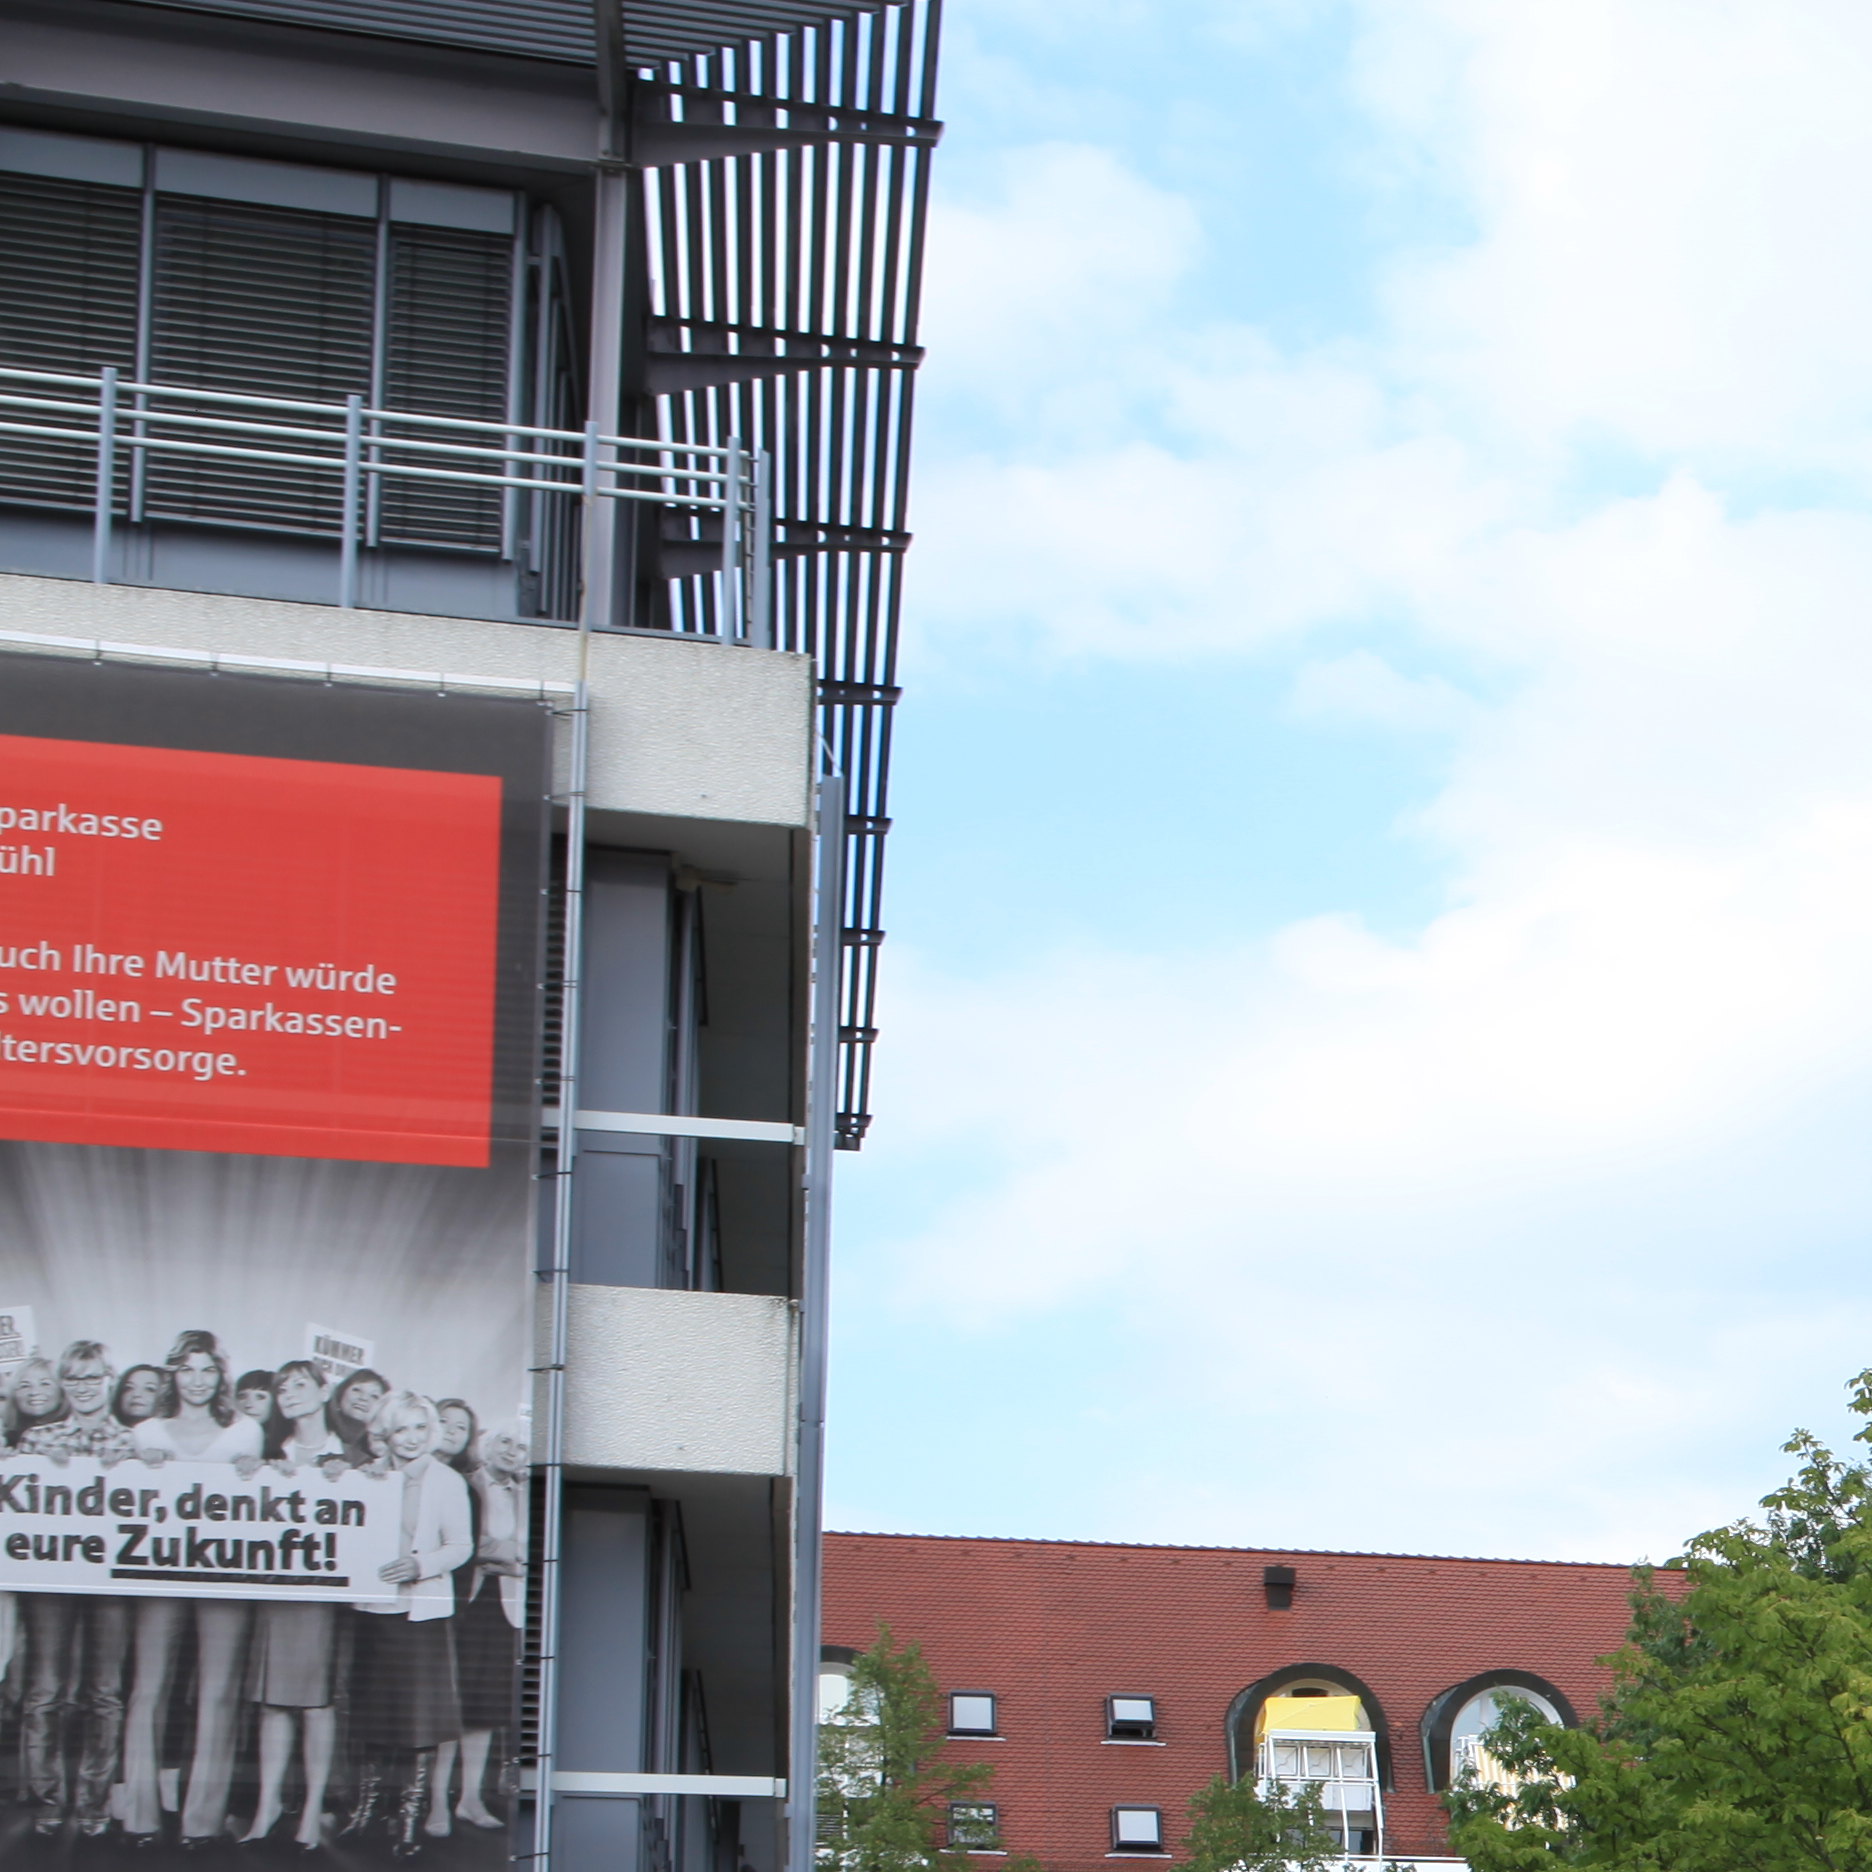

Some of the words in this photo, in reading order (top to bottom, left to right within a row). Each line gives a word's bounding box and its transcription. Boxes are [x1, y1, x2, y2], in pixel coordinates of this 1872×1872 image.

[73, 943, 145, 977] Ihre
[155, 950, 278, 988] Mutter
[285, 961, 397, 995] würde
[18, 988, 141, 1023] wollen
[180, 997, 402, 1041] Sparkassen-
[0, 1474, 168, 1524] Kinder,
[175, 1483, 306, 1524] denkt
[314, 1497, 367, 1527] an
[5, 1529, 107, 1564] eure
[115, 1523, 338, 1573] Zukunft!
